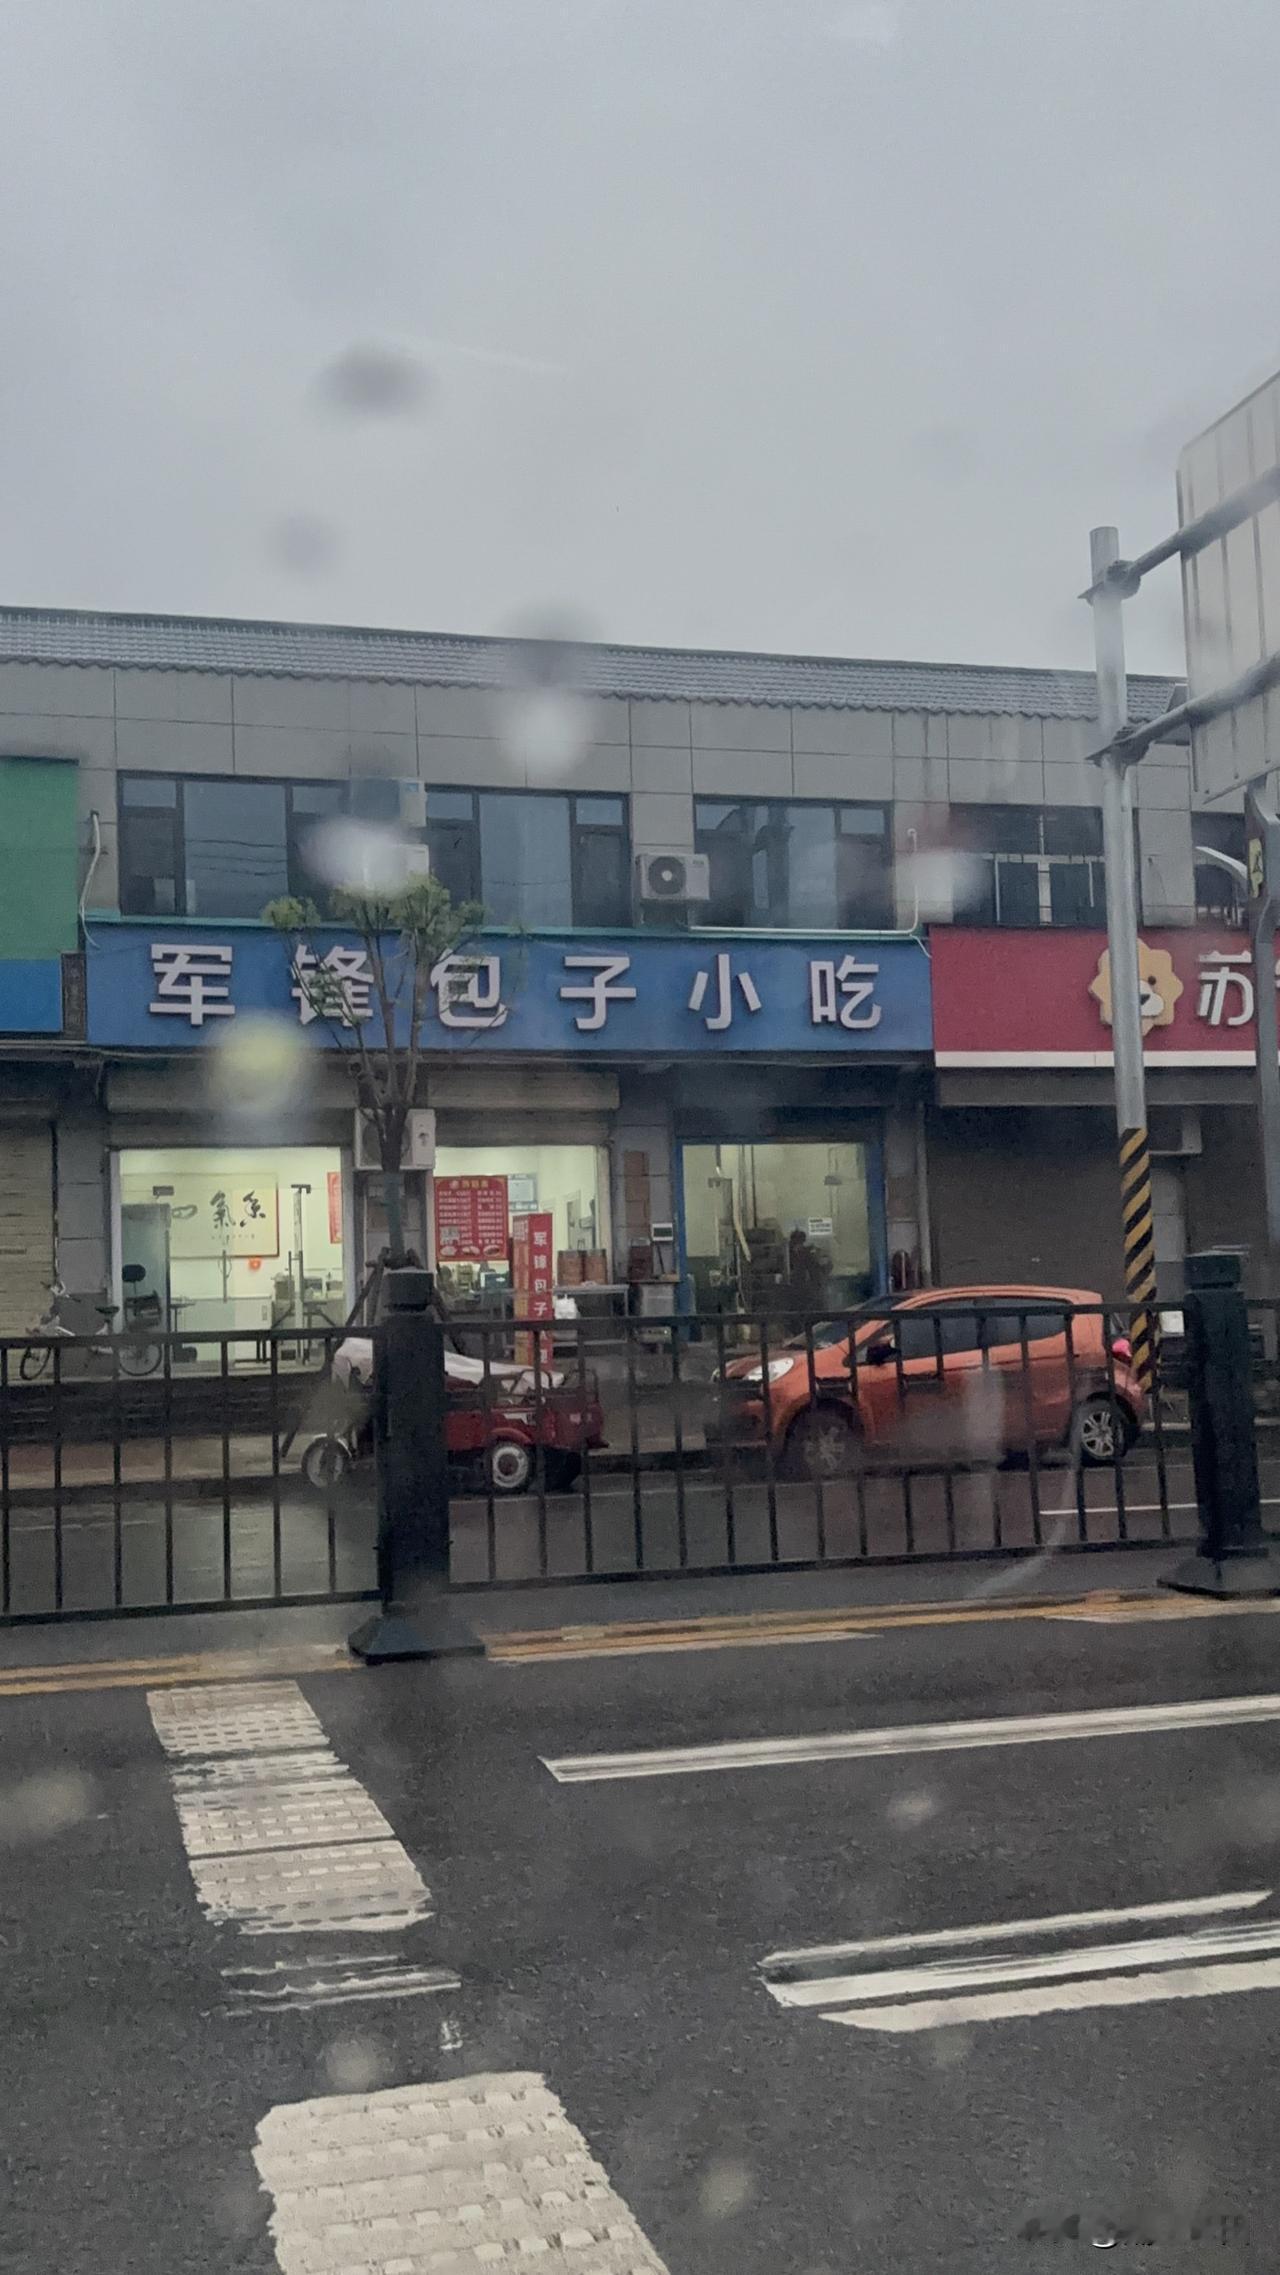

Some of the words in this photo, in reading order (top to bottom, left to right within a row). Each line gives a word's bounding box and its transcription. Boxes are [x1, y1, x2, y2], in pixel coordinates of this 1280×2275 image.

[149, 943, 882, 1032] 军锋包子小吃
[1197, 949, 1280, 1027] 苏
